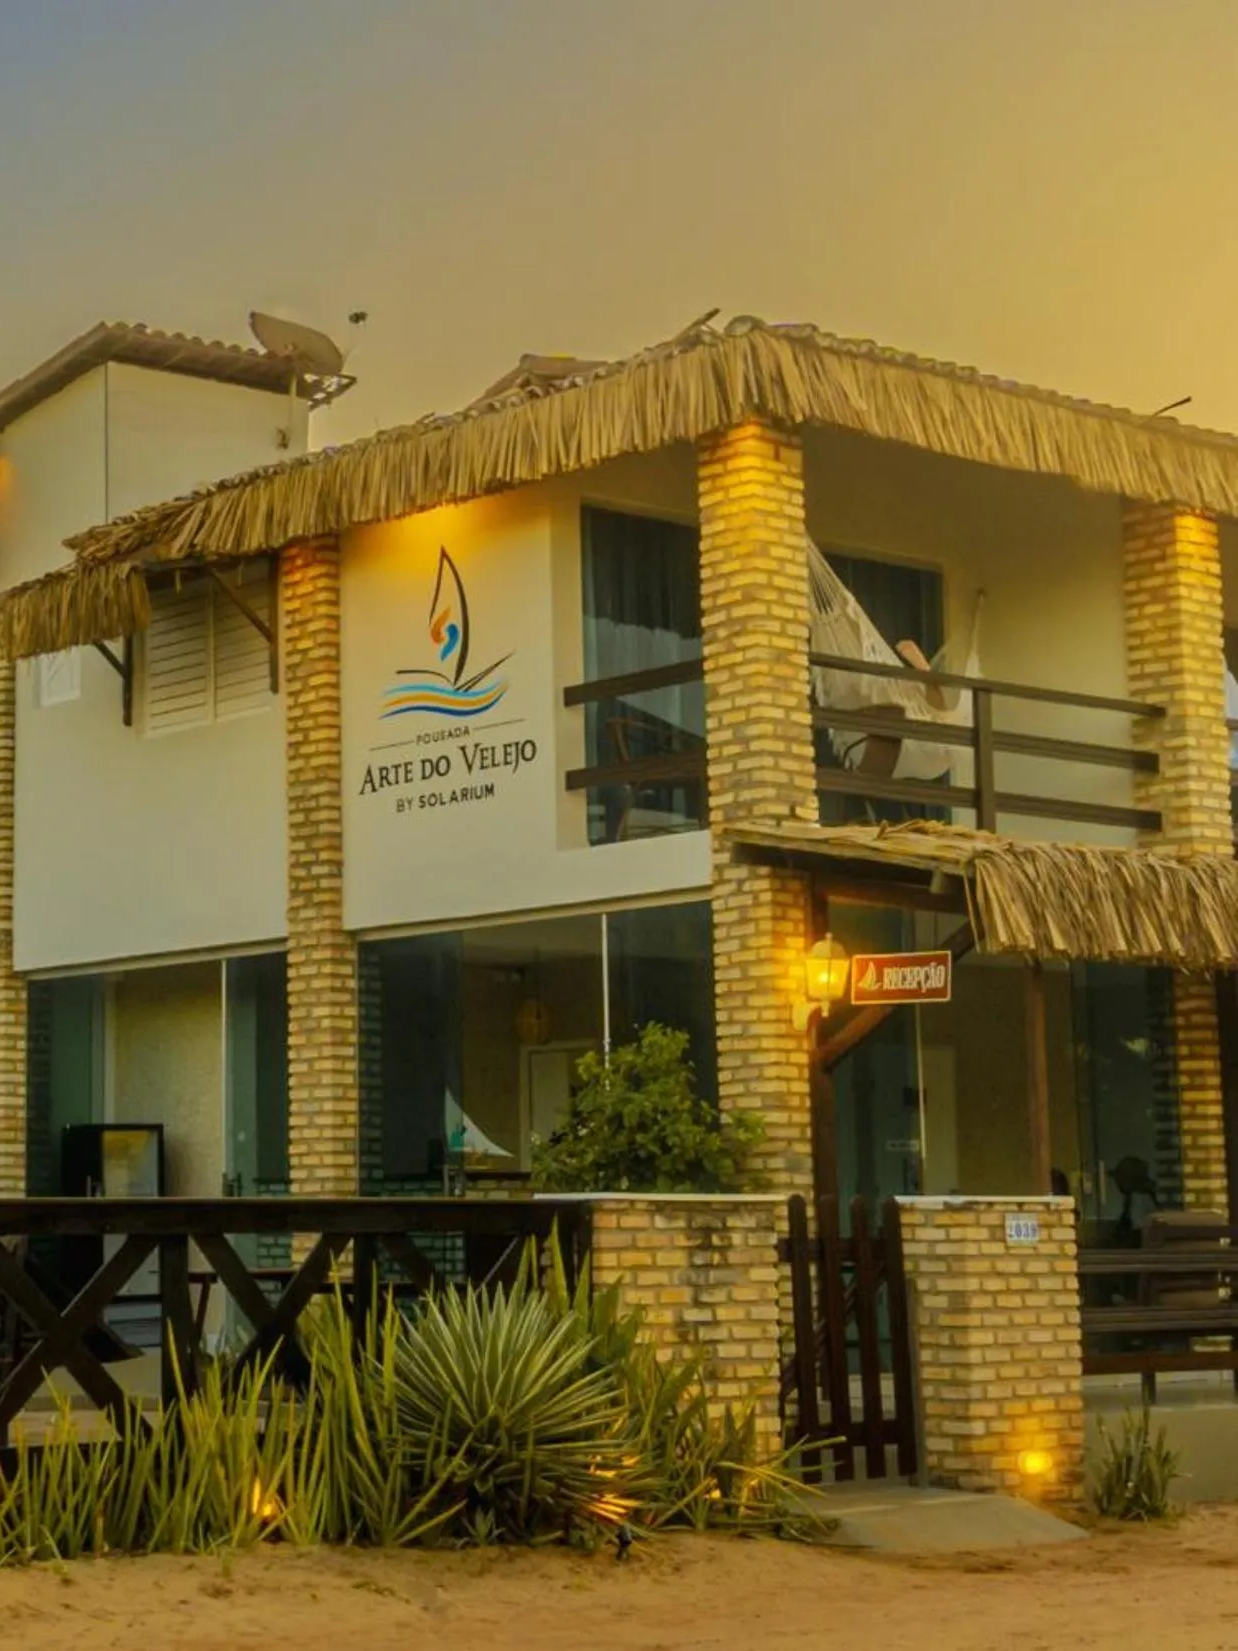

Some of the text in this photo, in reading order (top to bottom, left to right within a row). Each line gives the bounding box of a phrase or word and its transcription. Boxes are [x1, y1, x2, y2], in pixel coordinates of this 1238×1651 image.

[415, 726, 470, 745] POUSADA
[359, 739, 537, 795] ARTE DO VELEJO
[396, 783, 495, 813] BY SOLARIUM
